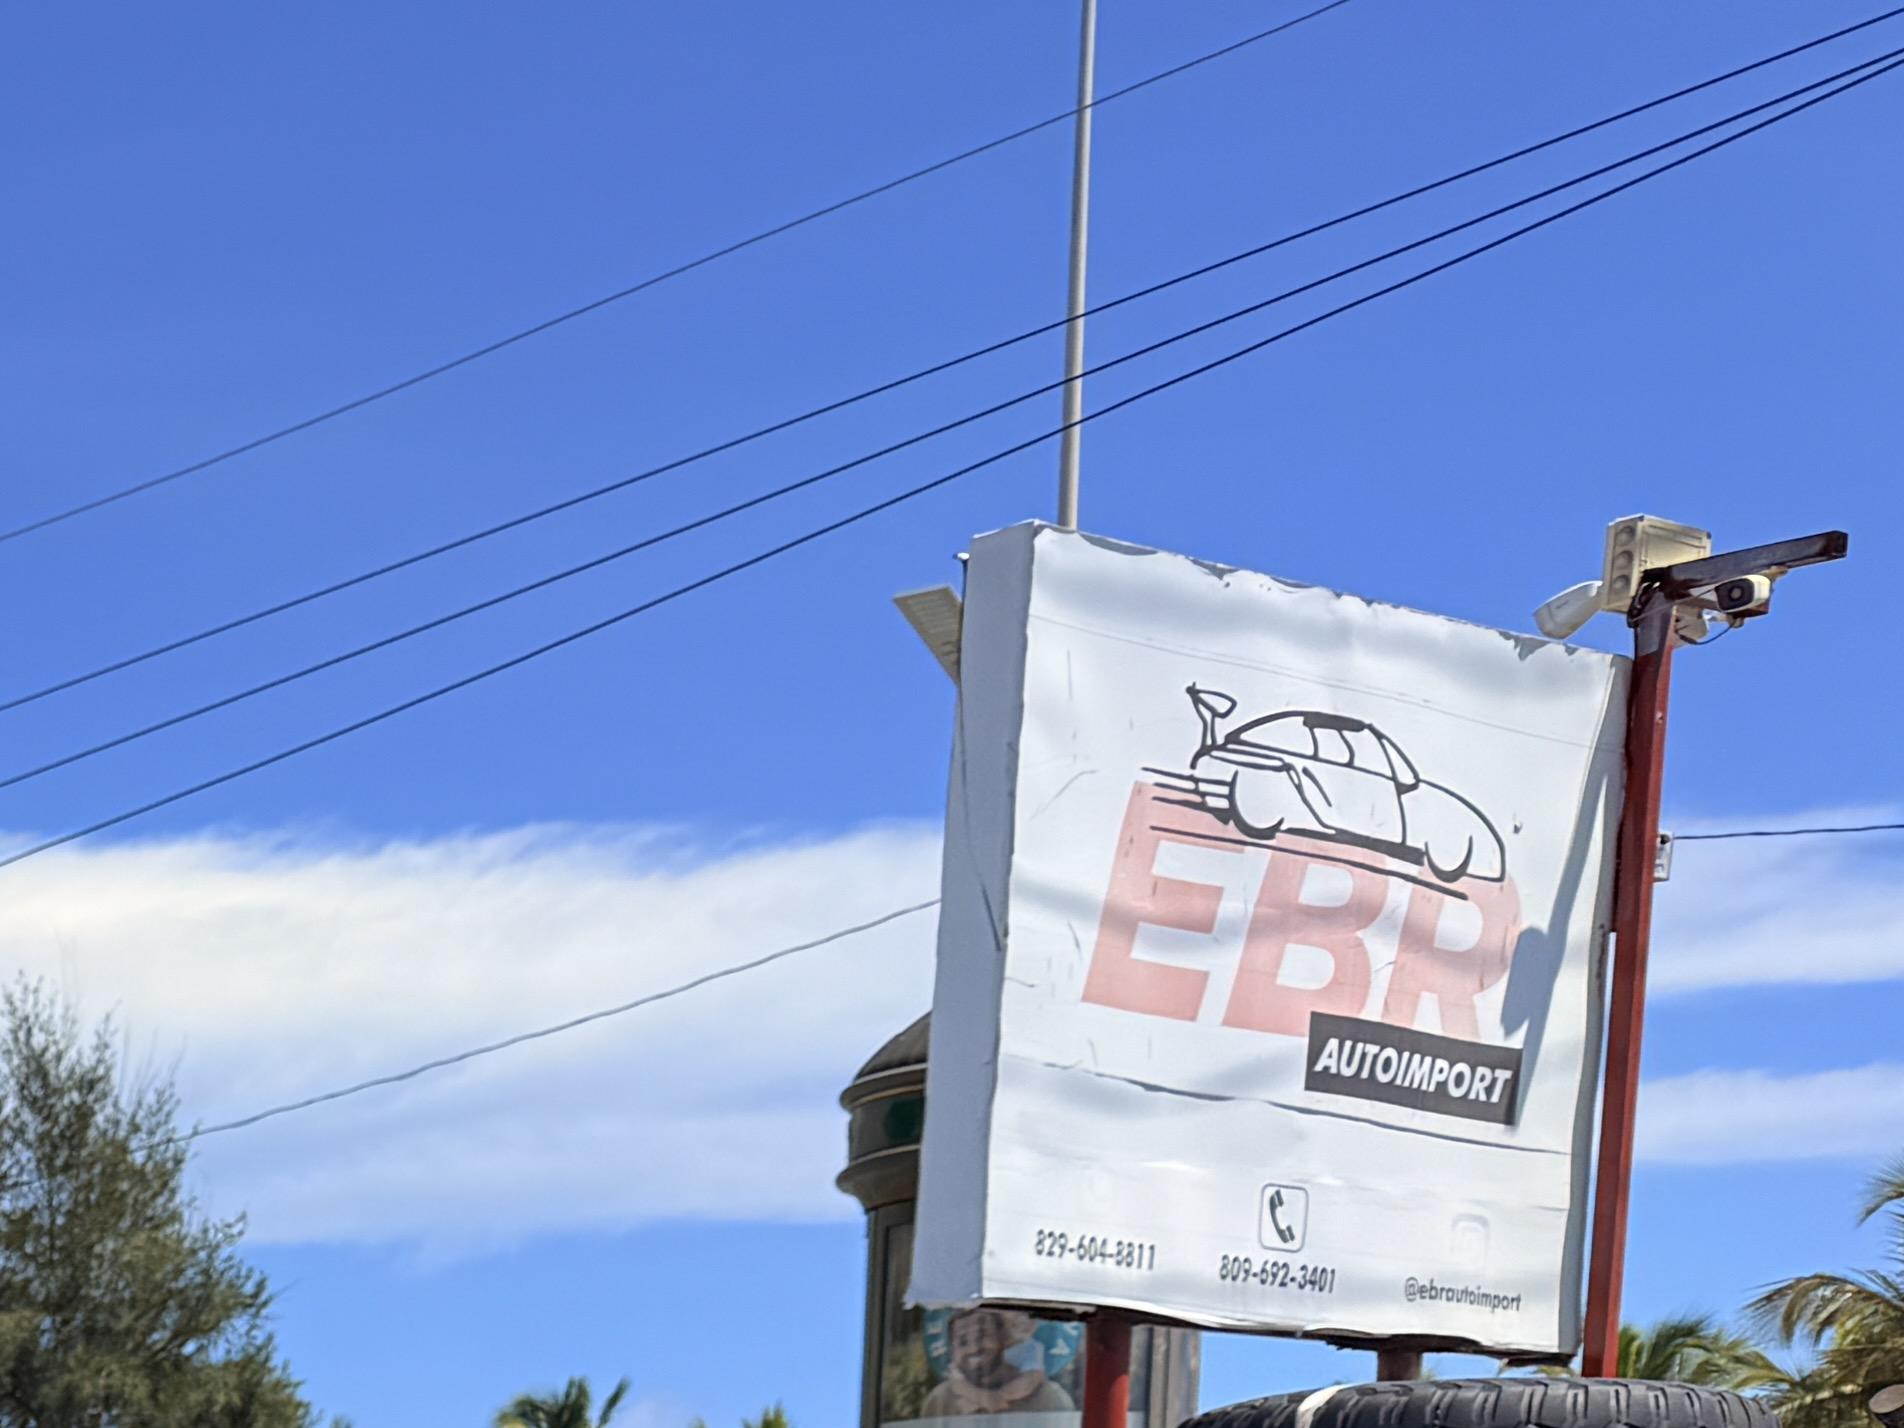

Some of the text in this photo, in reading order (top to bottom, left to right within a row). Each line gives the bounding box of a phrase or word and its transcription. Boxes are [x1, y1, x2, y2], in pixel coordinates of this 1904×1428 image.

[1081, 780, 1521, 1041] EBR
[1315, 1036, 1512, 1106] AUTOIMPORT
[1034, 1229, 1156, 1271] 829-604-8811
[1219, 1254, 1337, 1294] 809-692-3401
[1404, 1276, 1522, 1312] @ebrautoimport
